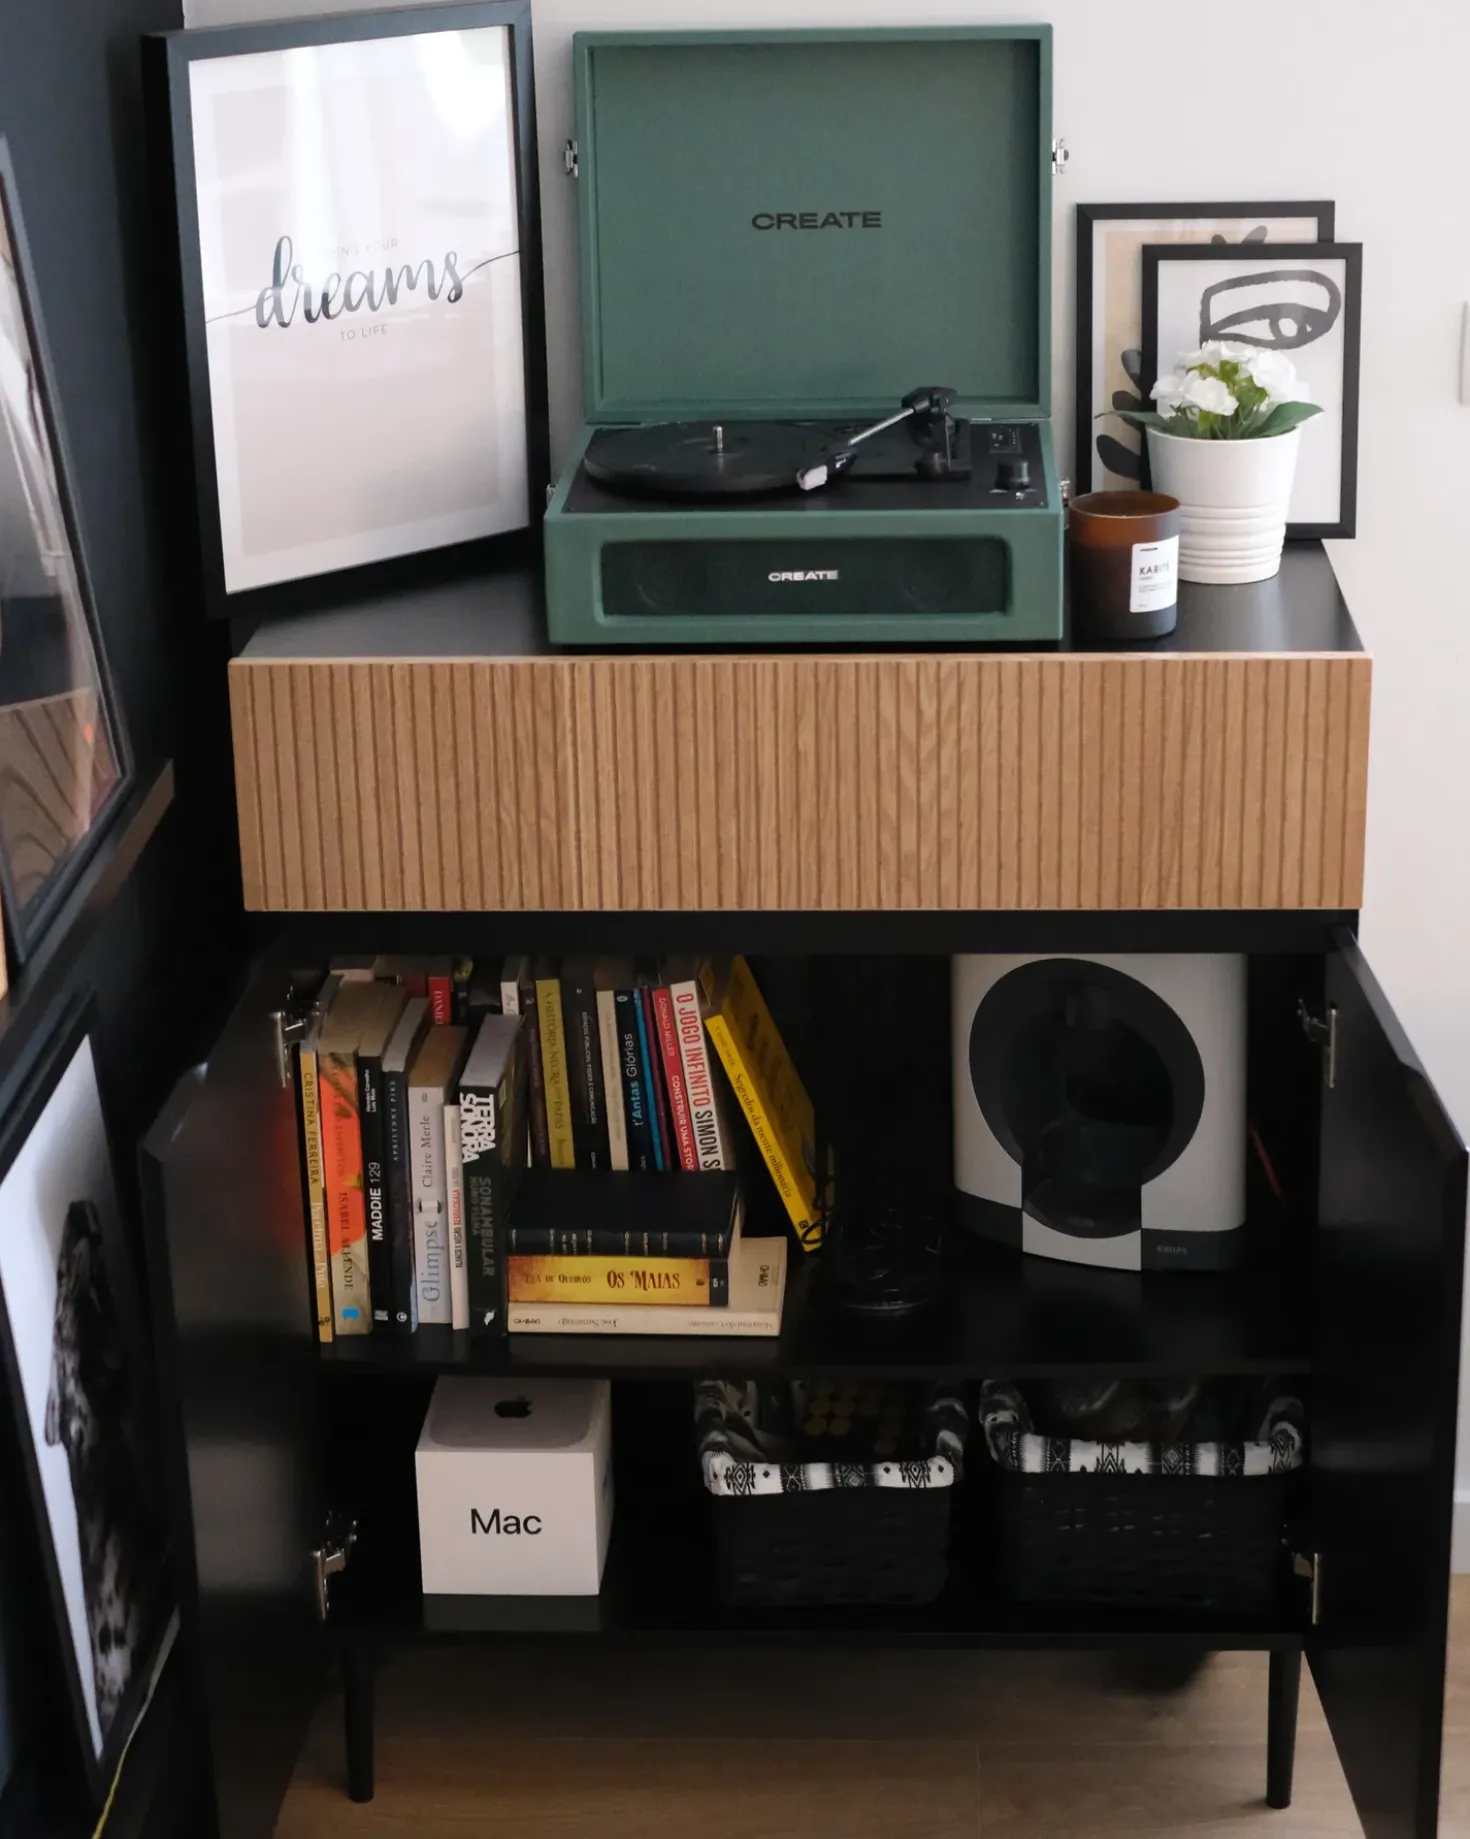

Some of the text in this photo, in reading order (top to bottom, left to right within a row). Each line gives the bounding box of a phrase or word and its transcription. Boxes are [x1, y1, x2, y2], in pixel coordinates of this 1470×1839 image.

[751, 211, 882, 230] CREATE
[256, 236, 463, 328] dreams
[341, 324, 388, 341] TO LIFE
[768, 570, 838, 582] CREATE
[660, 998, 675, 1057] DONALD MILLER
[624, 1034, 637, 1077] Glórias
[676, 993, 711, 1107] O JOGO INFINITO
[672, 1075, 687, 1126] CONSTRUIR
[680, 1126, 690, 1147] UMA
[735, 1074, 756, 1113] Segredos
[303, 1072, 319, 1184] CRISTINA FERREIRA
[420, 1116, 432, 1148] Merle
[460, 1092, 480, 1164] SONORA
[474, 1094, 496, 1153] TERRA
[695, 1110, 719, 1156] SIMON
[752, 1113, 764, 1127] da
[757, 1126, 773, 1154] mente
[421, 1152, 433, 1188] Claire
[368, 1162, 383, 1241] MADDIE 129
[340, 1192, 354, 1290] ISABEL ALLENDE
[421, 1220, 444, 1302] Glimpse
[630, 1270, 681, 1291] MAIAS
[471, 1508, 542, 1535] Mac
